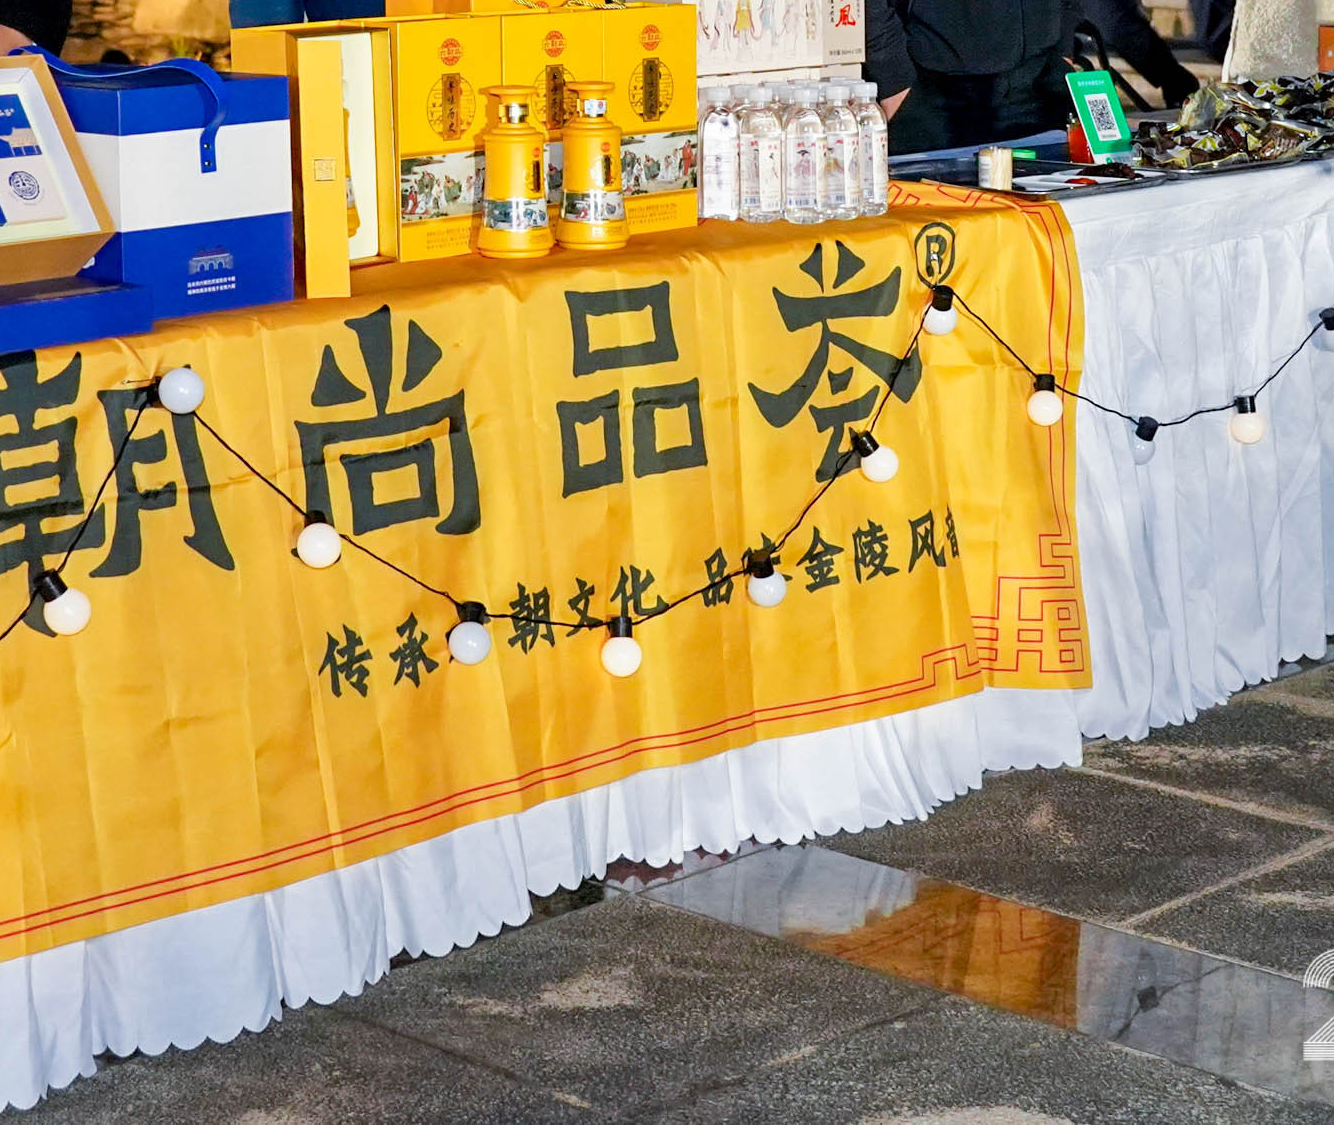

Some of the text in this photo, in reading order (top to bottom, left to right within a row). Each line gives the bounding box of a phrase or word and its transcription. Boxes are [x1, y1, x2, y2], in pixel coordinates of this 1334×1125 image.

[317, 564, 670, 699] 传承朝文化
